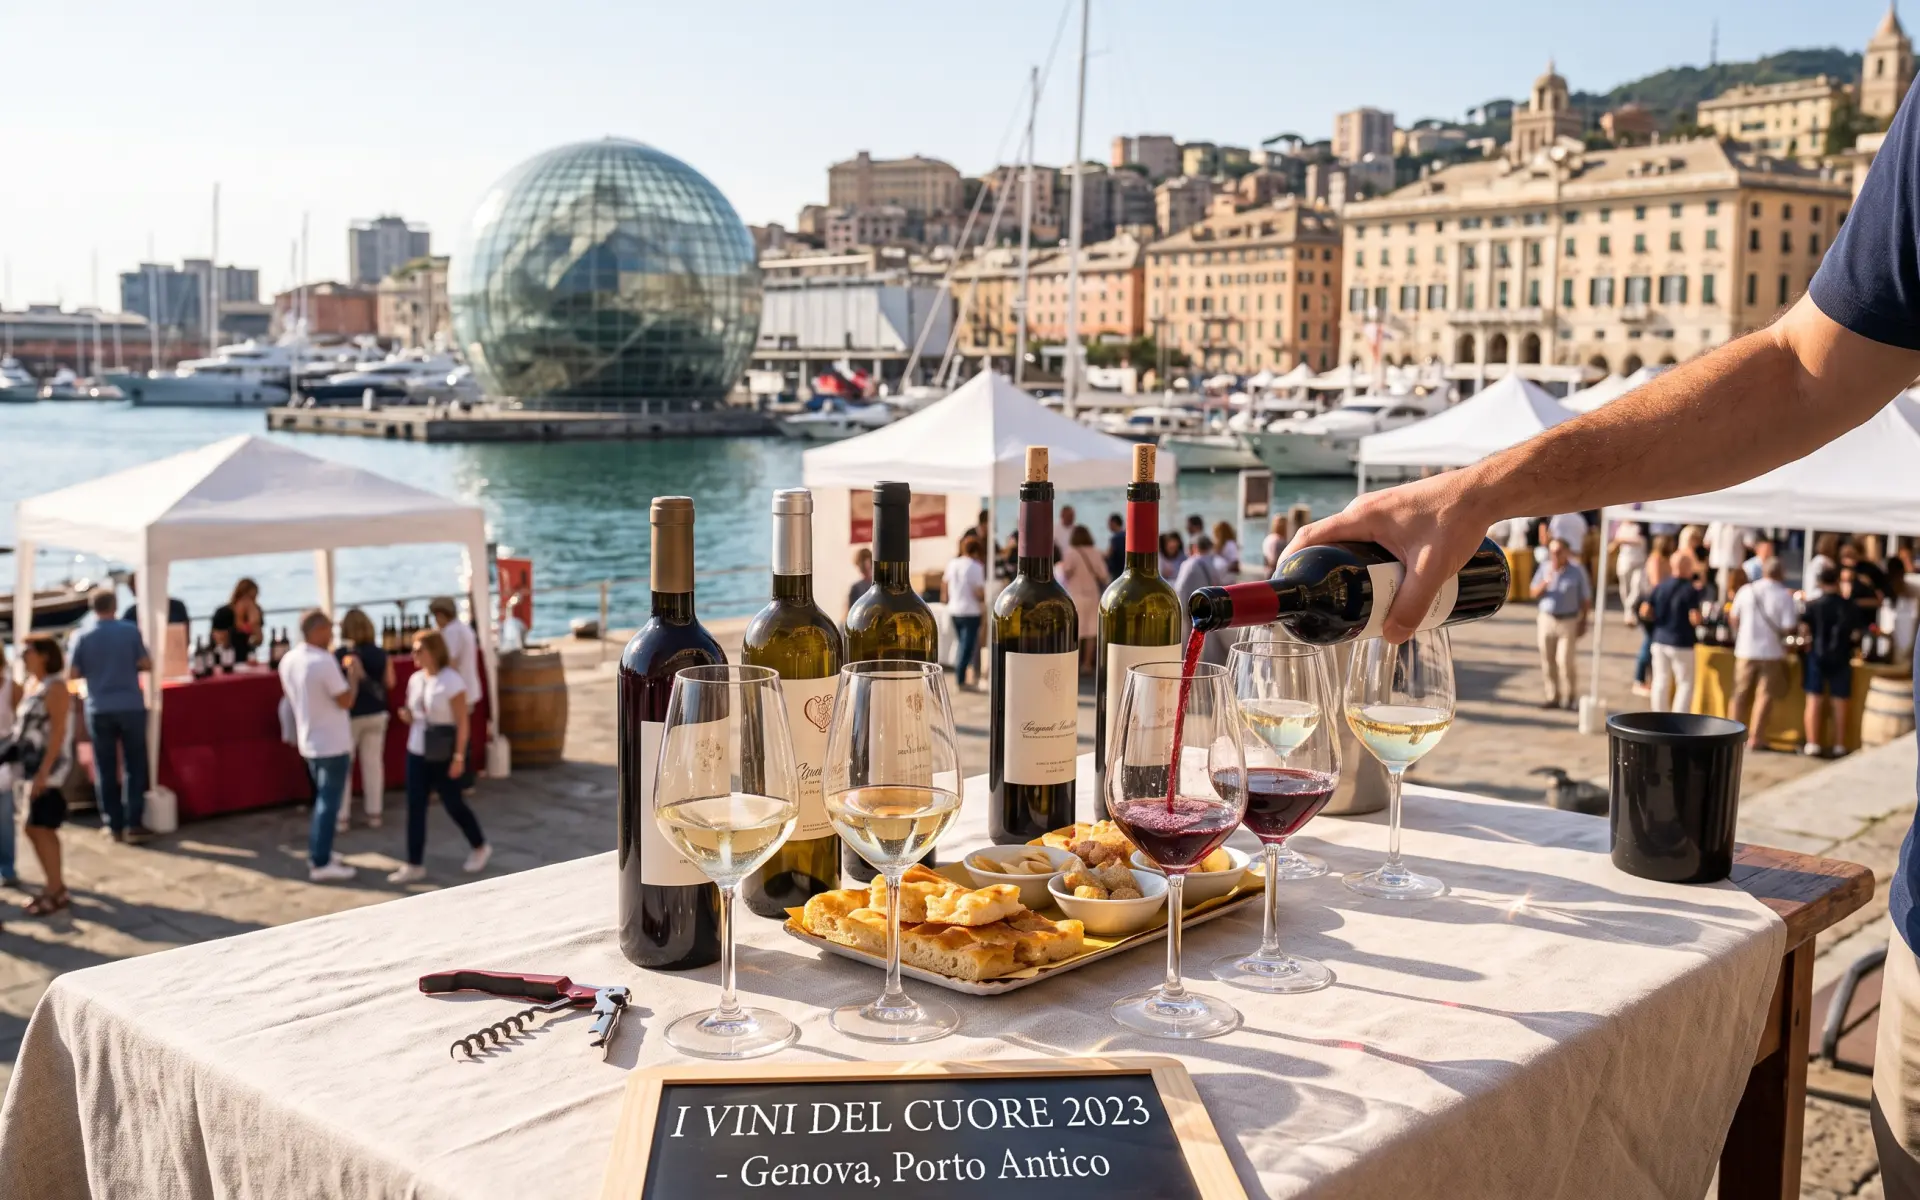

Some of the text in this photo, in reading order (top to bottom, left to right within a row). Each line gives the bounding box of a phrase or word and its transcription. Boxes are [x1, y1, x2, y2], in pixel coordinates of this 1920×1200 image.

[670, 1095, 1150, 1138] I VINI DEL CUORE 2023
[740, 1154, 881, 1188] Genova,
[892, 1151, 986, 1182] Porto
[997, 1147, 1110, 1179] Antico
